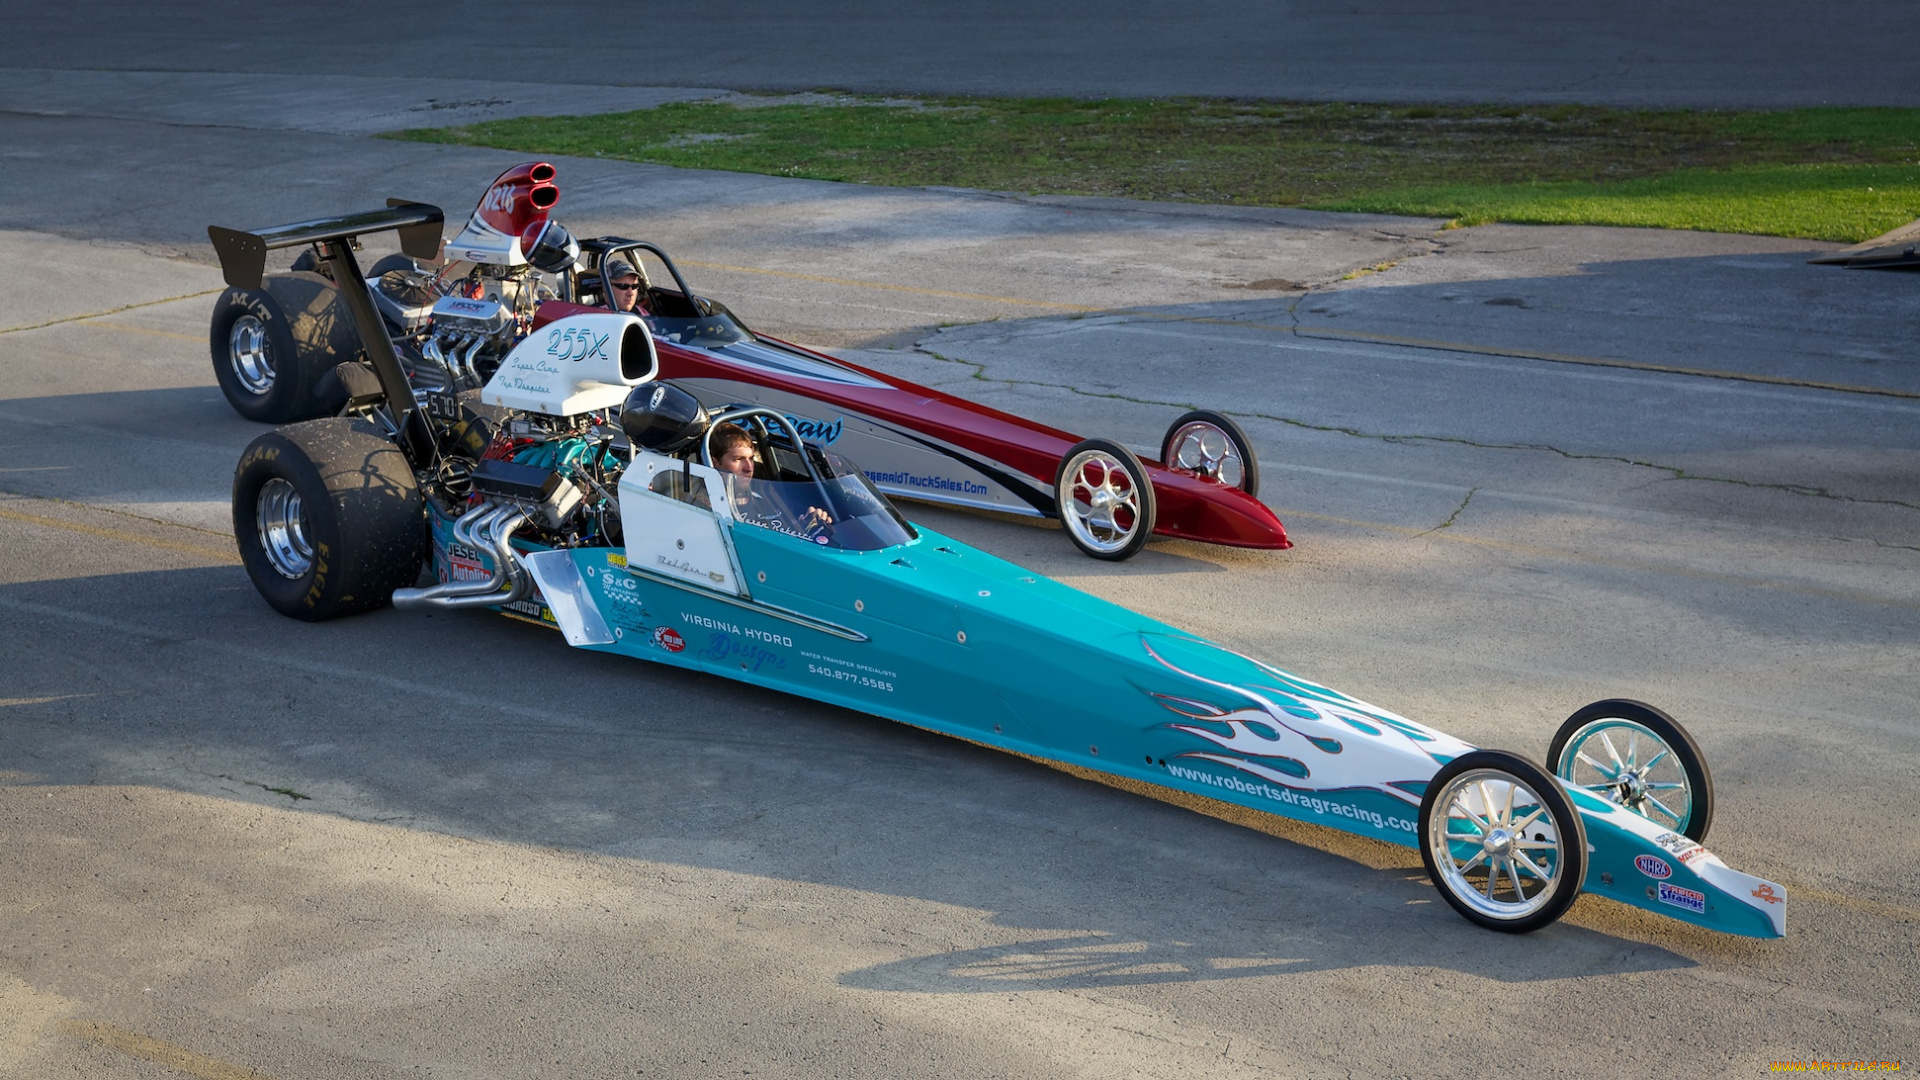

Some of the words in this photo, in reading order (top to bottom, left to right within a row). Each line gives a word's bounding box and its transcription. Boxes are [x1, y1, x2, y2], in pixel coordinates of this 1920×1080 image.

[547, 328, 609, 361] 255X
[681, 612, 741, 636] VIRGINIA
[745, 627, 793, 648] HYDRO
[699, 632, 786, 673] Designs
[800, 651, 821, 660] WATER
[822, 655, 855, 668] TRANSFER
[856, 663, 897, 678] SPECIALISTS
[808, 664, 894, 692] 540.877.5585
[1640, 858, 1667, 875] NHRA
[1660, 889, 1704, 909] Strange
